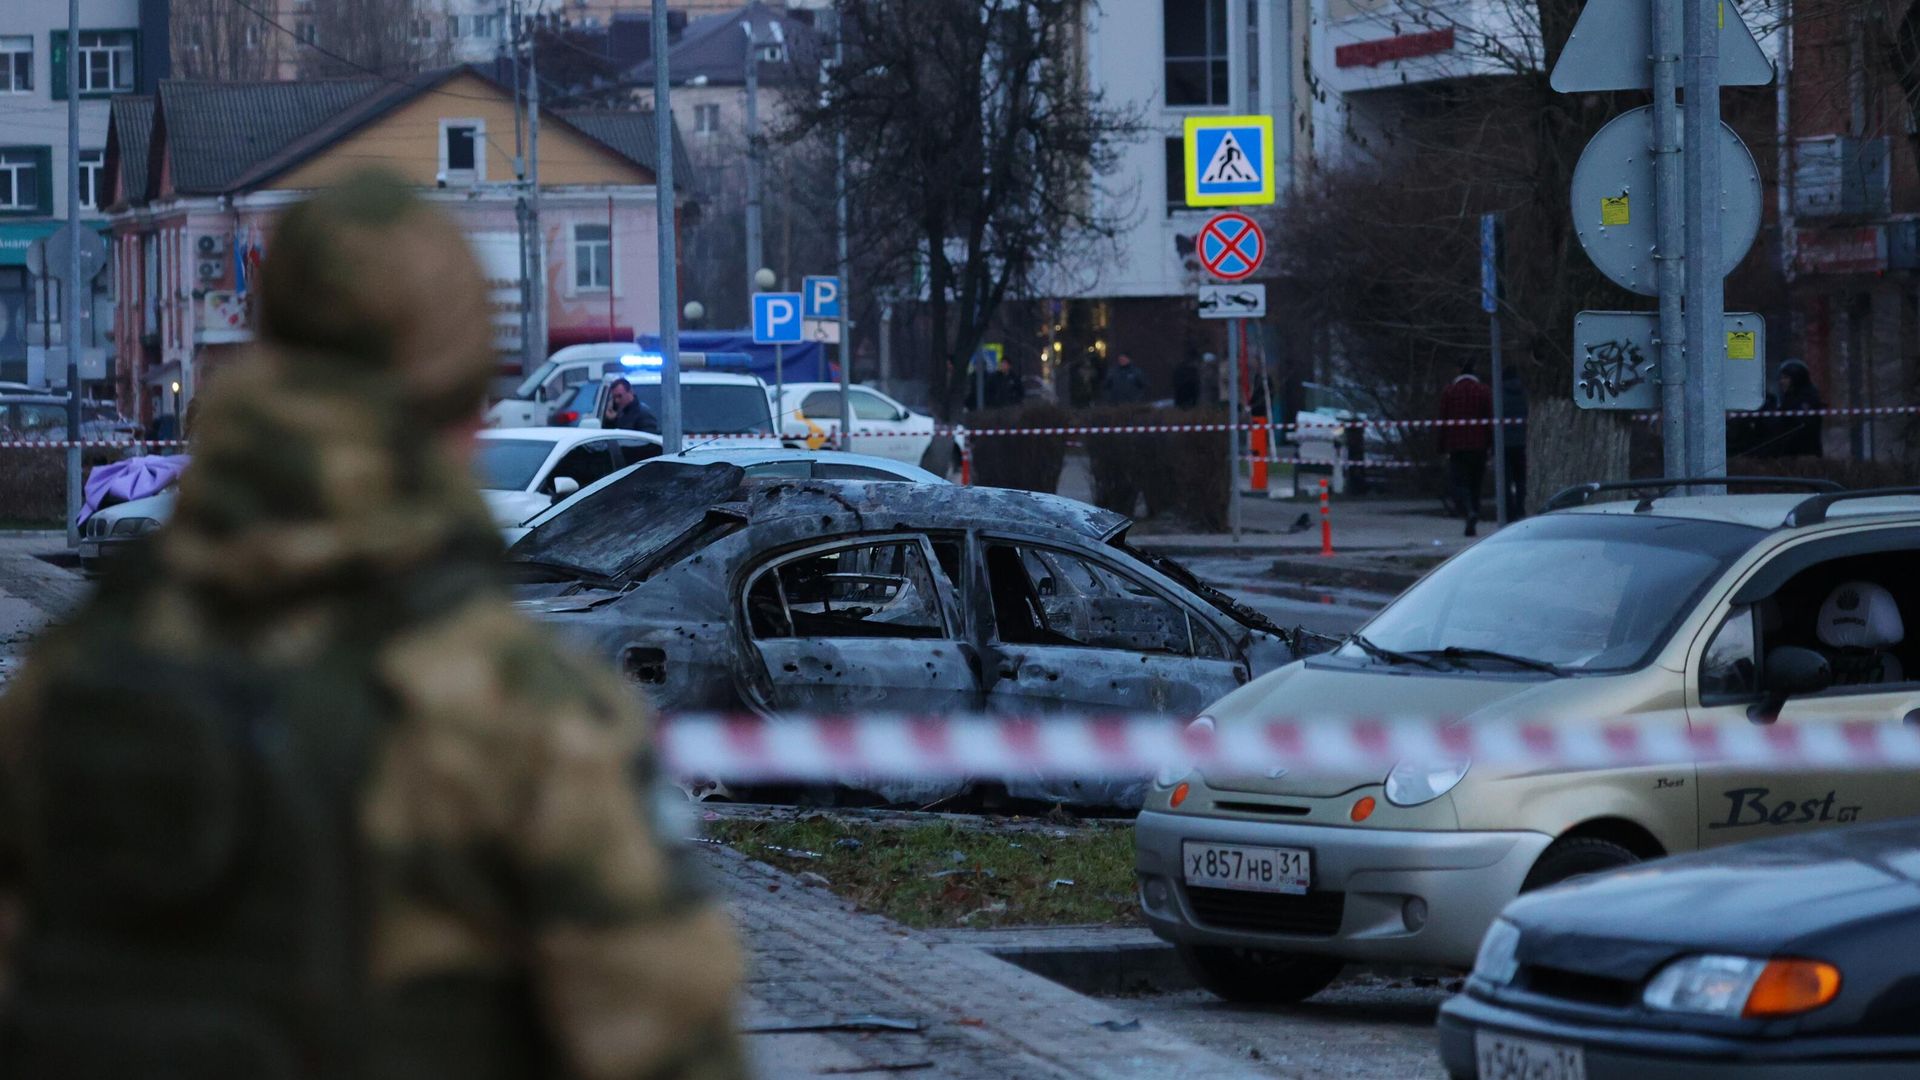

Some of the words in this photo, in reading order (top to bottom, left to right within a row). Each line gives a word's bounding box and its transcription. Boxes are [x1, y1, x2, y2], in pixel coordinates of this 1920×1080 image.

[814, 281, 837, 314] P
[766, 299, 793, 339] P
[1654, 777, 1685, 790] Best
[1708, 787, 1836, 830] Best
[1837, 805, 1862, 823] GT
[1280, 853, 1301, 875] 31
